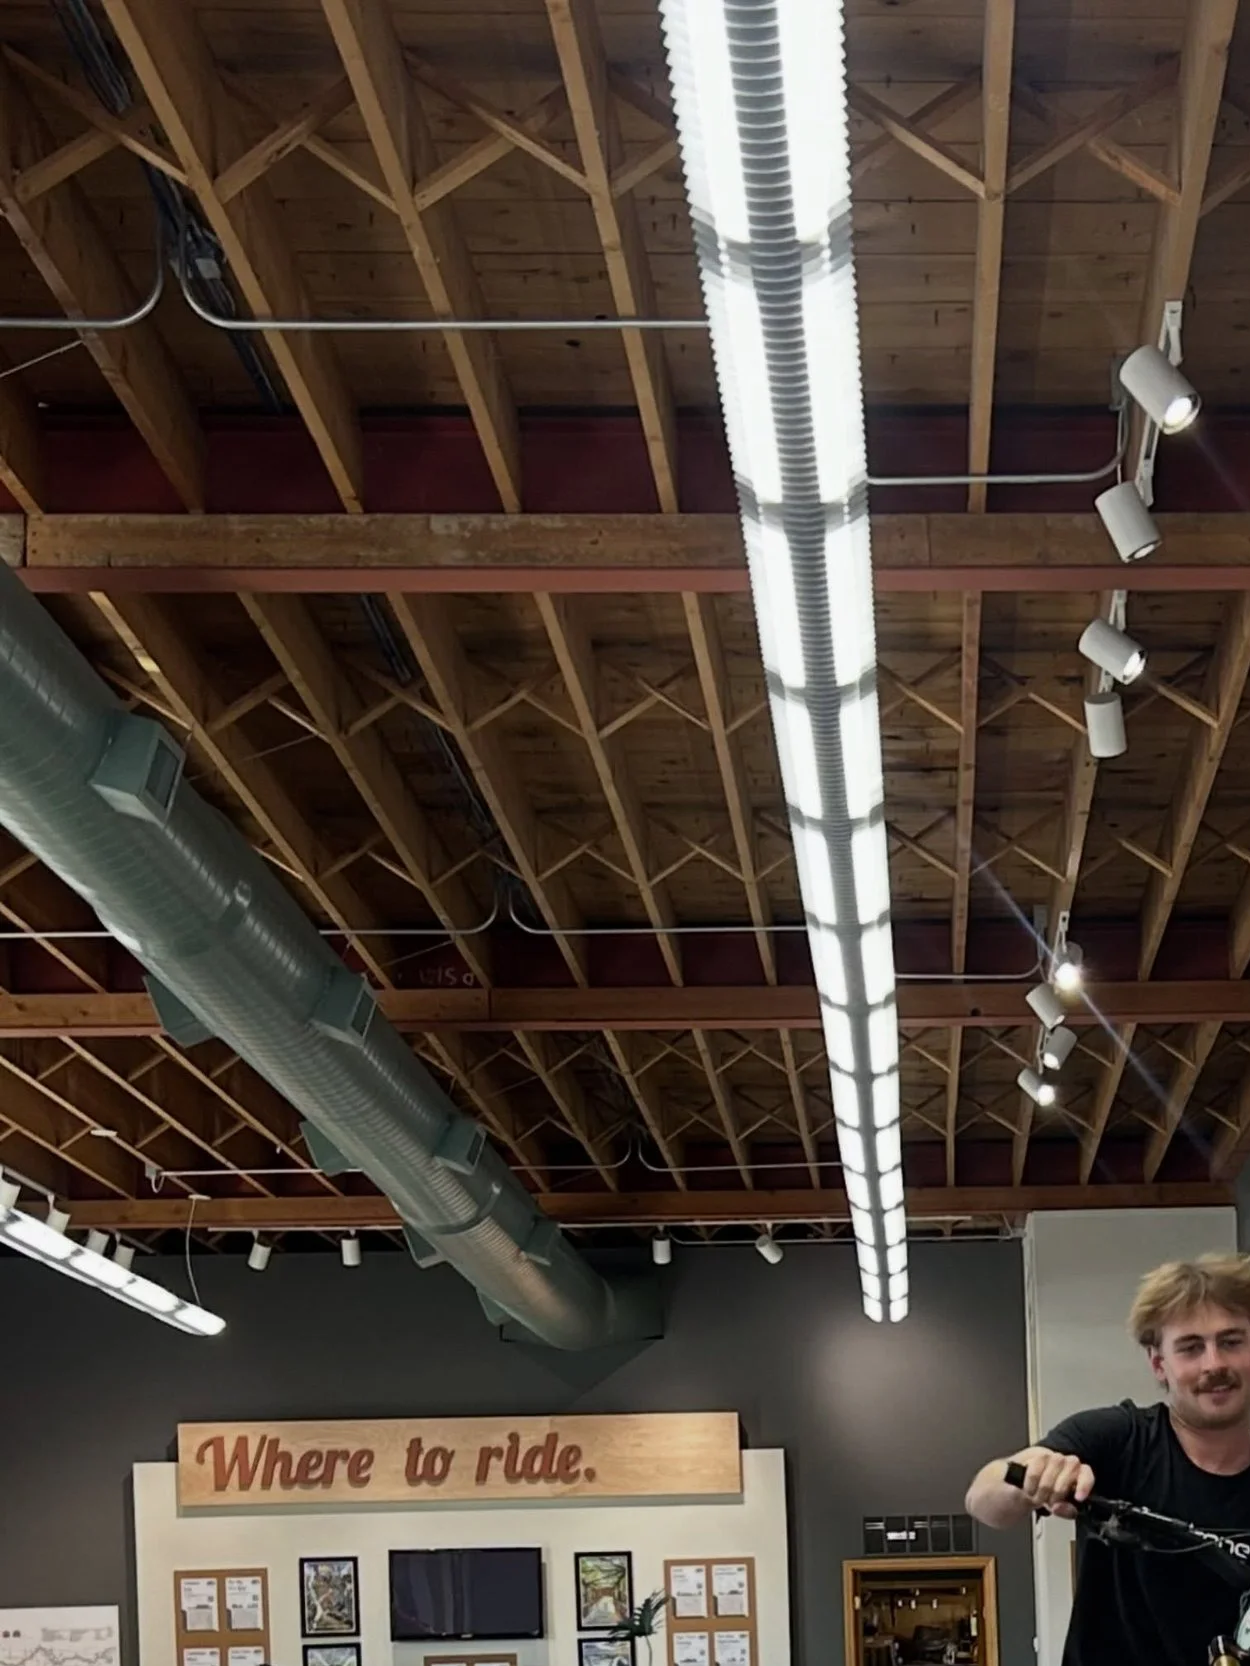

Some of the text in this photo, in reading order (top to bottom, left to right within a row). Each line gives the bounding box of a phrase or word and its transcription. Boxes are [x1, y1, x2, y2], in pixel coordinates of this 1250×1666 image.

[196, 1432, 597, 1490] Where to ride.
